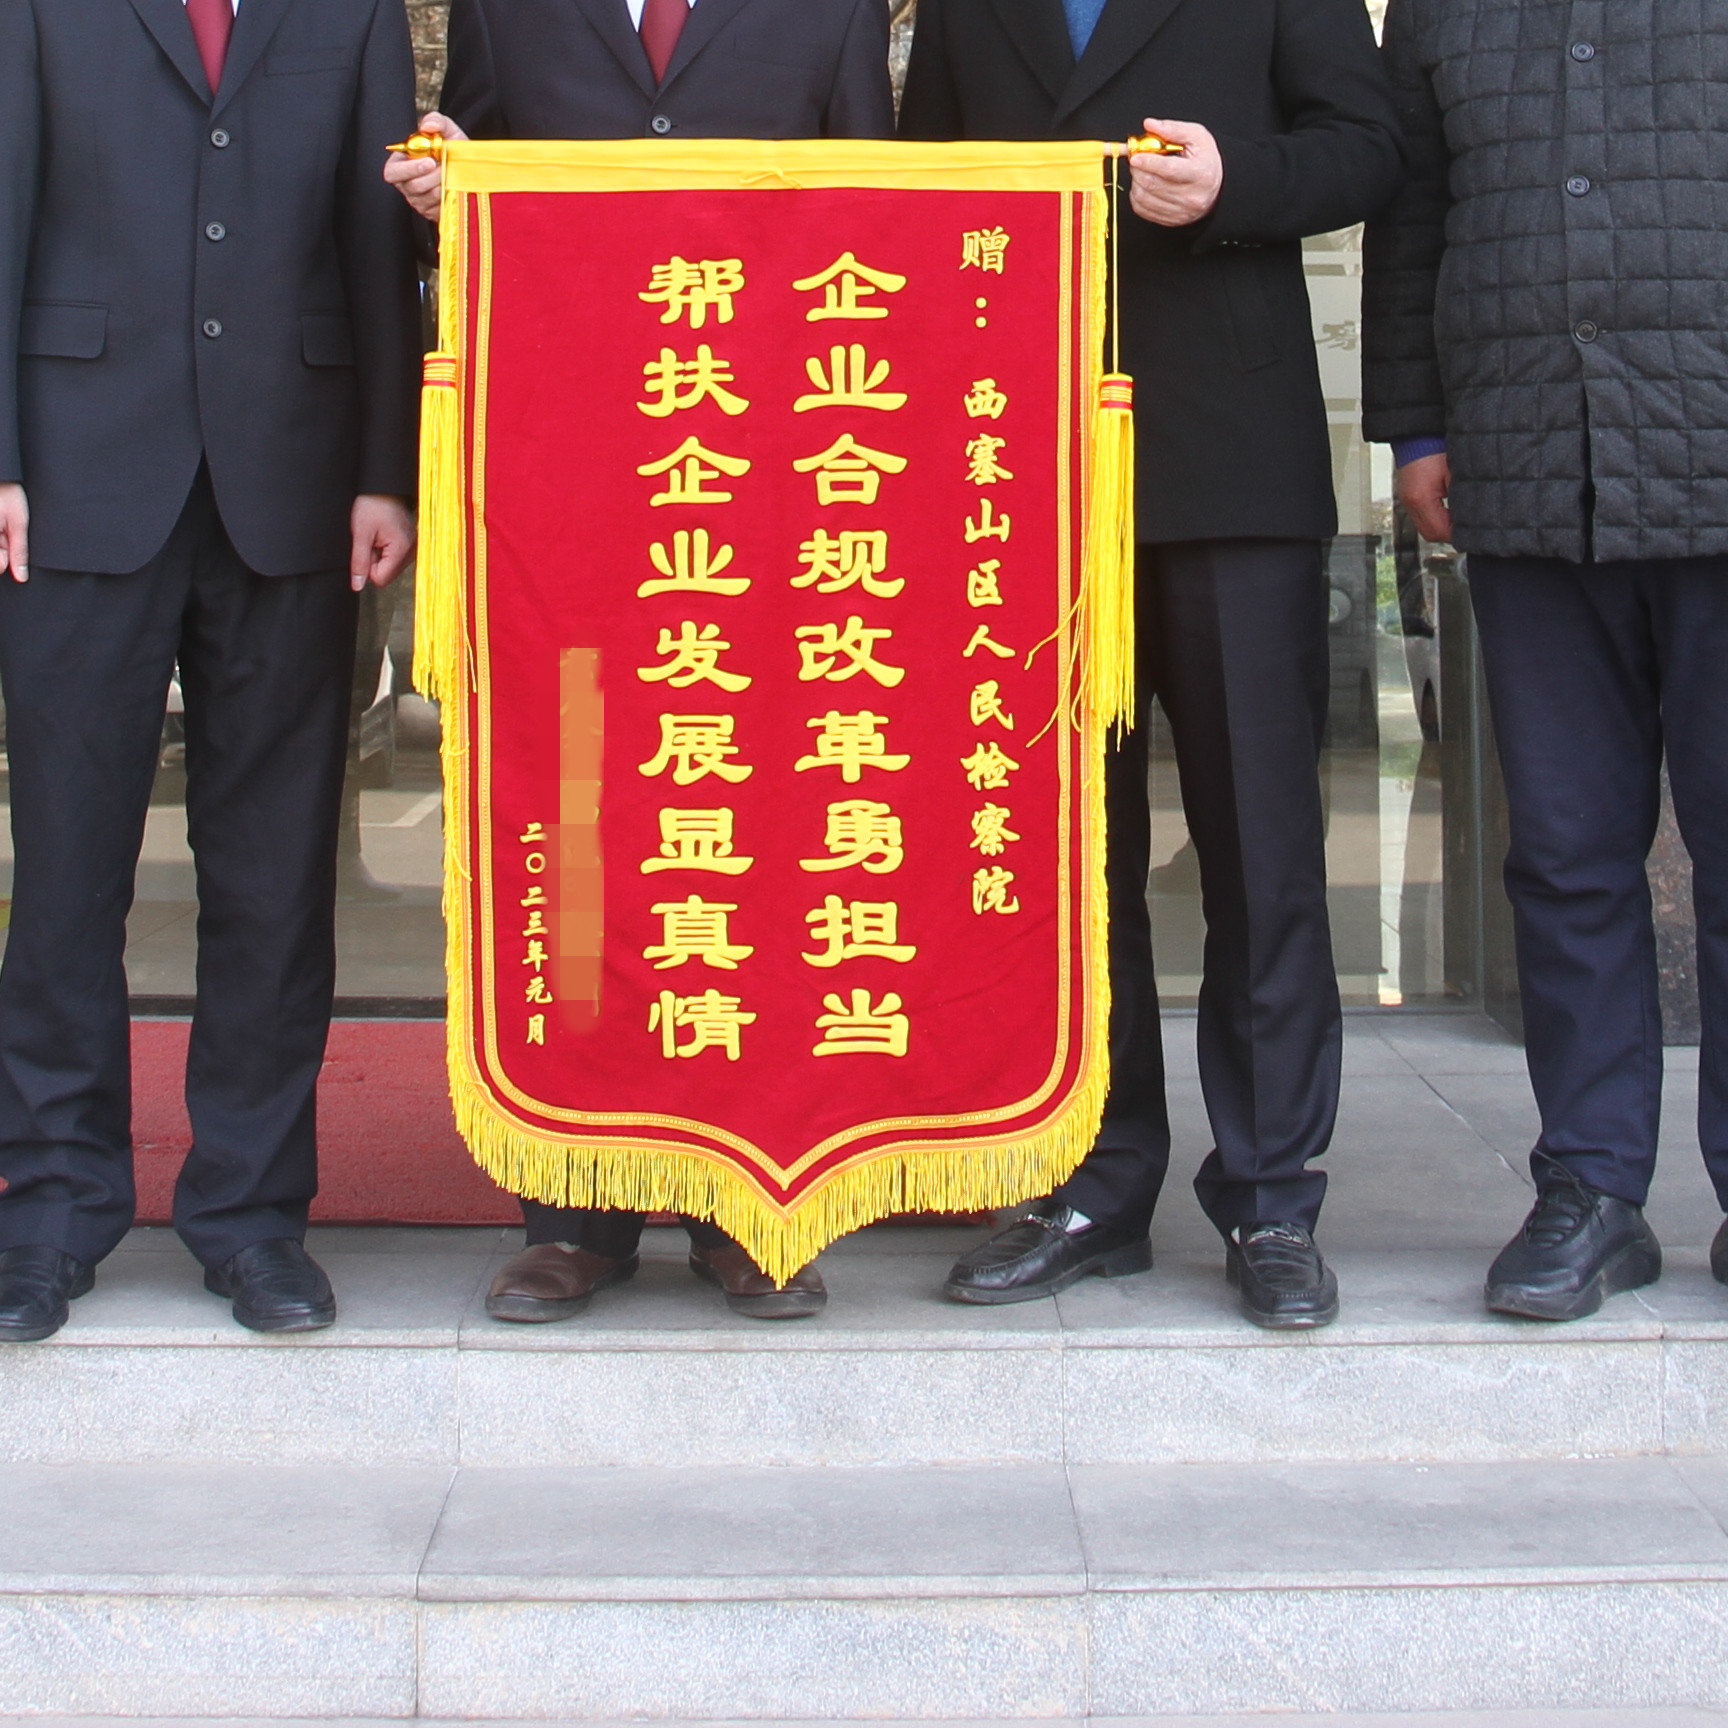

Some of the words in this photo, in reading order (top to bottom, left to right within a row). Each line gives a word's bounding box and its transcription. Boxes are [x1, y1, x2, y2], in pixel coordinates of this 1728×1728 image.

[635, 255, 758, 1062] 帮扶企业发展显真情
[790, 251, 918, 1059] 企业合规改革勇担当
